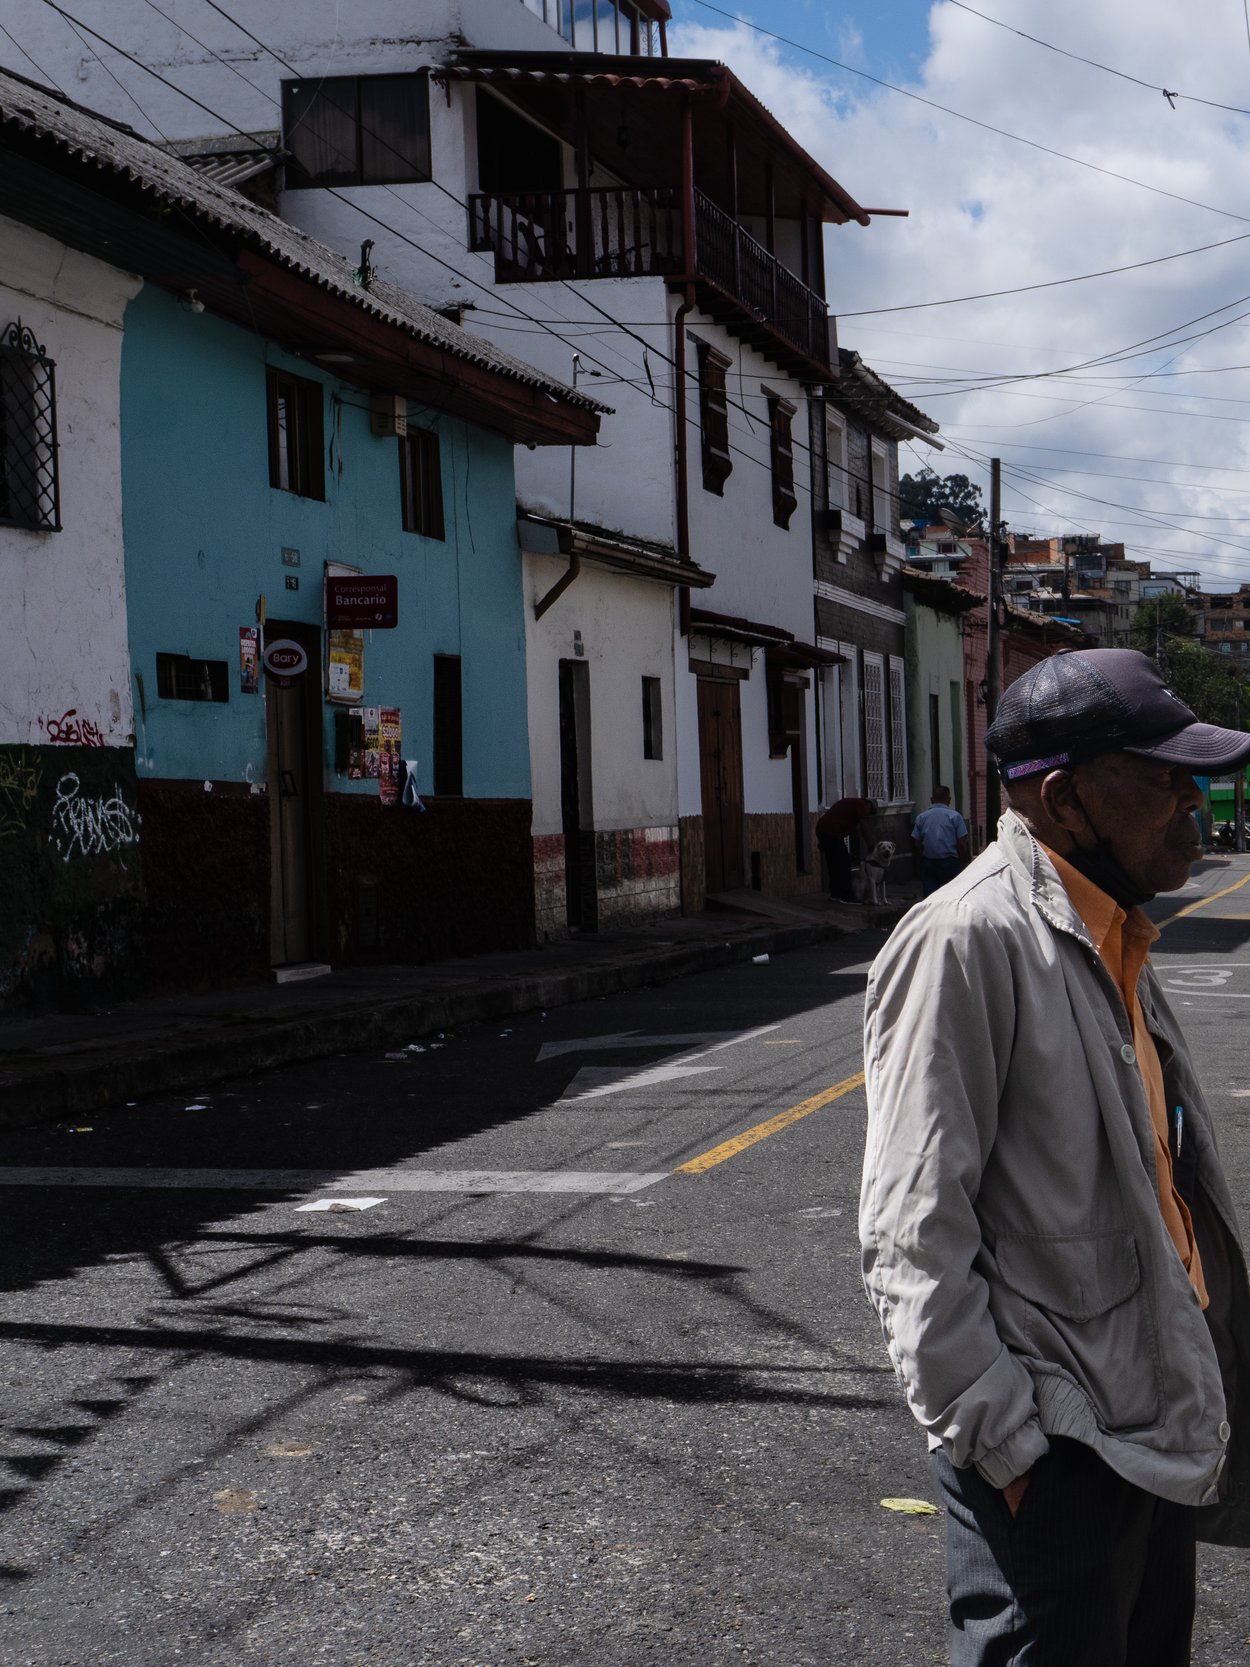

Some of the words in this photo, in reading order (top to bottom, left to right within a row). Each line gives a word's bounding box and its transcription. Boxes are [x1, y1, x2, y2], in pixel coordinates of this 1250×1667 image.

[334, 583, 387, 594] Corresponsal
[335, 594, 387, 606] Bancario
[273, 653, 299, 665] Bary
